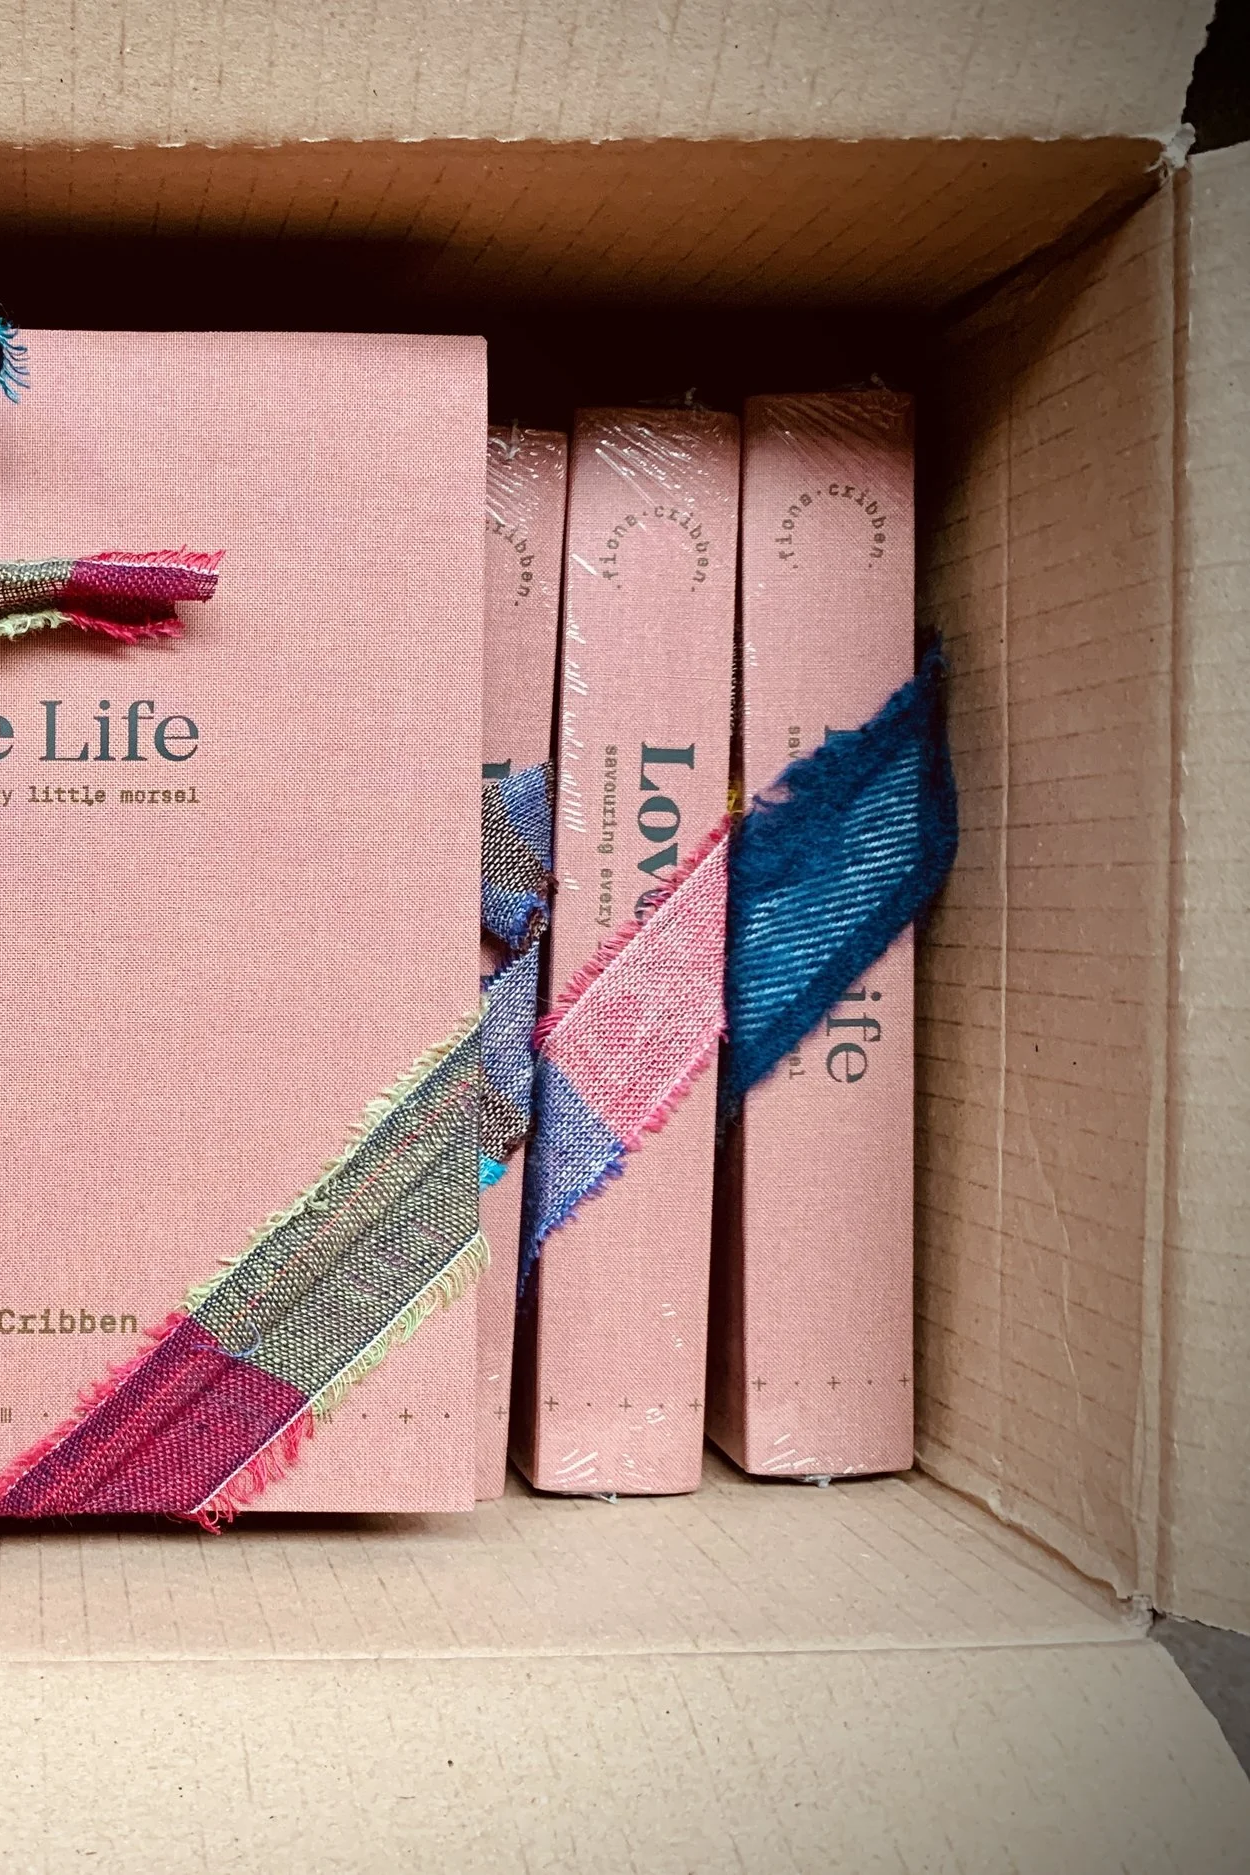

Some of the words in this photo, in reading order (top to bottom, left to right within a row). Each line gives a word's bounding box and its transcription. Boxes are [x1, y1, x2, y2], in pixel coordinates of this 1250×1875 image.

[40, 699, 200, 762] Life
[28, 786, 106, 806] little
[120, 786, 200, 804] morsel
[597, 744, 618, 854] savouring
[595, 868, 613, 928] every
[826, 985, 882, 1084] ife
